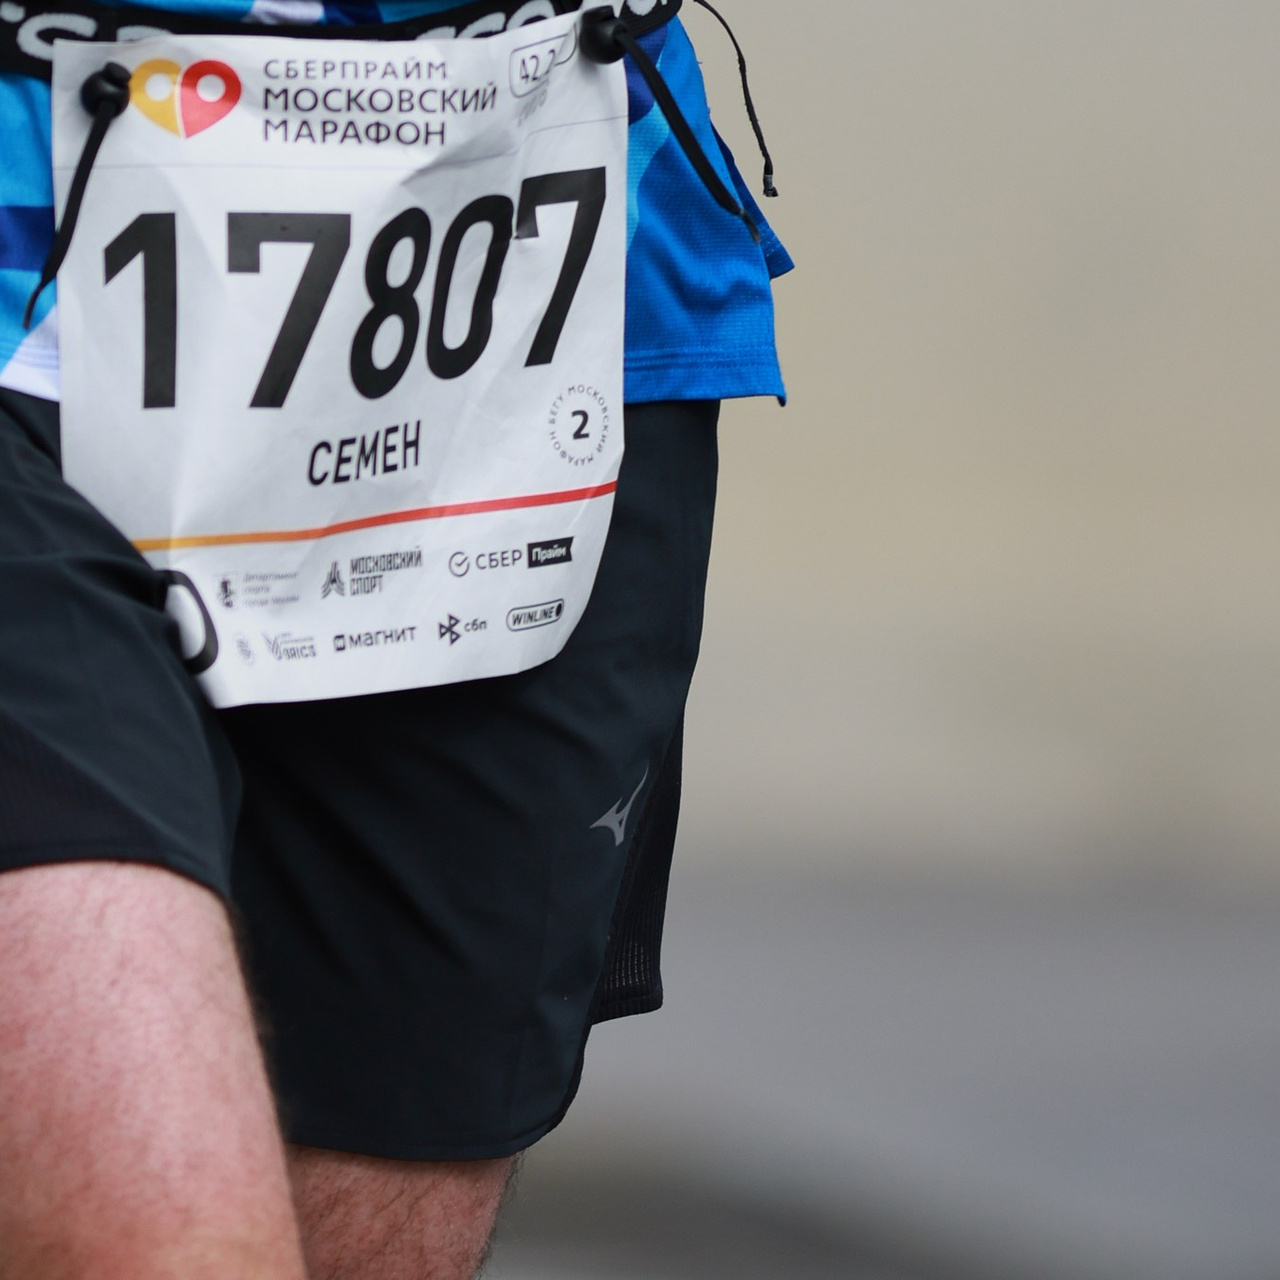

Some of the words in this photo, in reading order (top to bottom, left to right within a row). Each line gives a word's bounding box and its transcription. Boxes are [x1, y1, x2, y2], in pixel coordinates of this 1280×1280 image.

[263, 57, 448, 81] СБЕРПРАЙМ
[262, 81, 498, 114] МОСКОВСКИЙ
[263, 118, 446, 146] МАРАФОН
[104, 167, 607, 409] 17807
[571, 409, 590, 440] 2
[307, 419, 421, 486] СЕМЕН
[350, 545, 422, 574] МОСКОВСКИЙ
[475, 549, 522, 570] СБЕР
[531, 544, 567, 562] Прайм
[350, 574, 383, 596] СПОРТ
[511, 606, 555, 627] WINLINE
